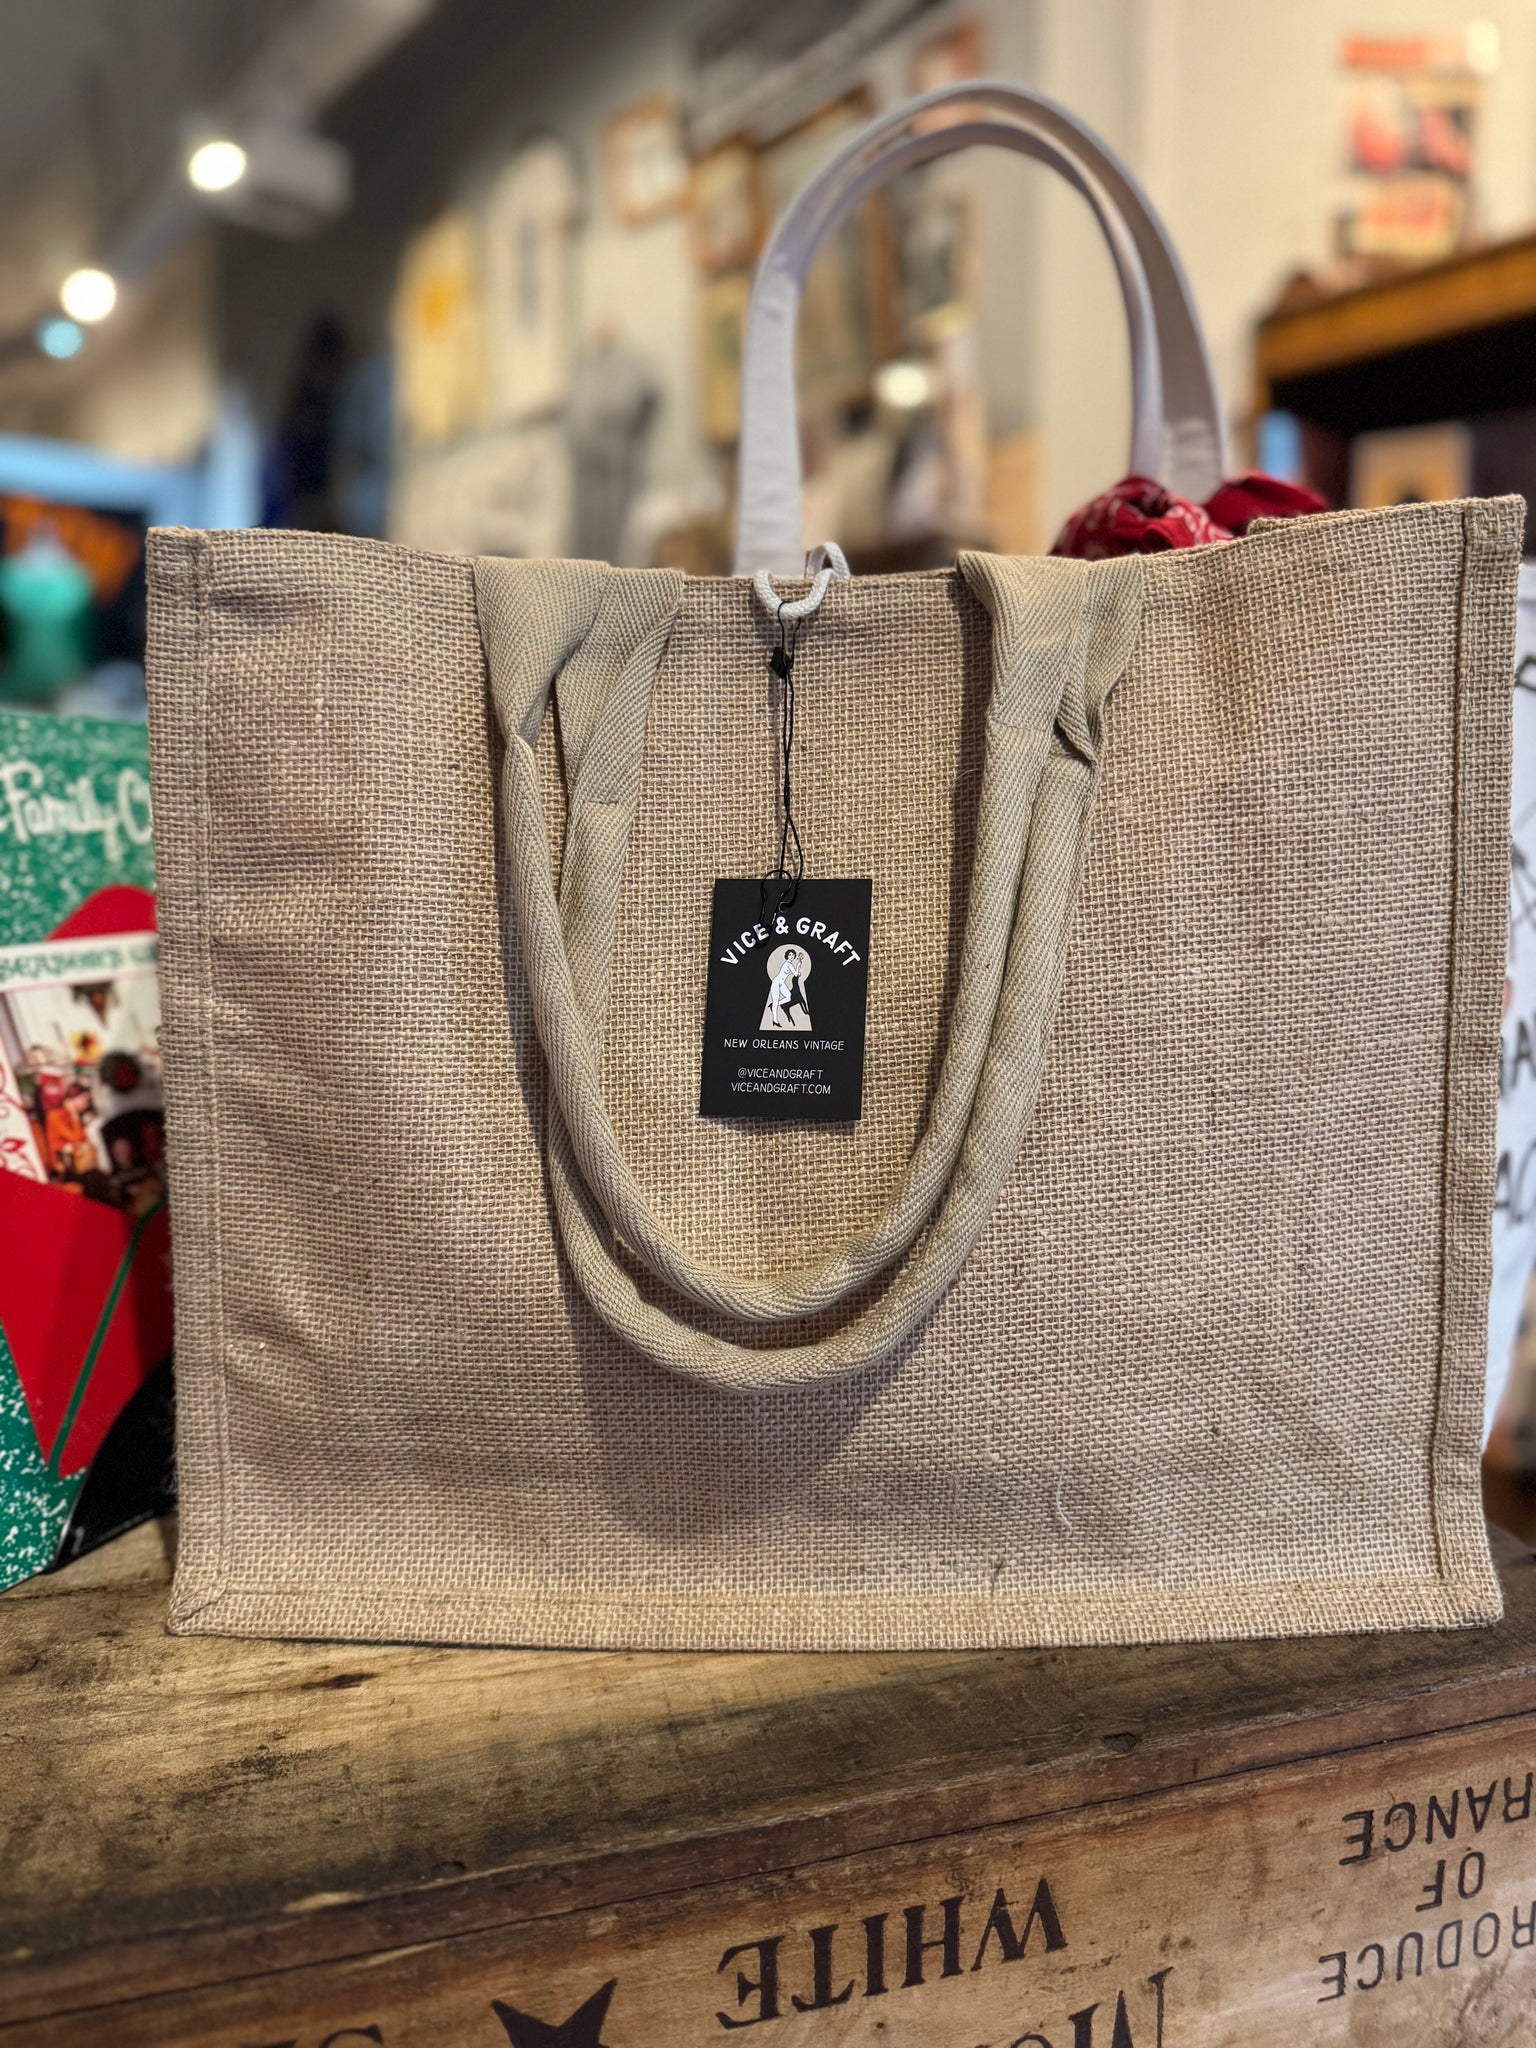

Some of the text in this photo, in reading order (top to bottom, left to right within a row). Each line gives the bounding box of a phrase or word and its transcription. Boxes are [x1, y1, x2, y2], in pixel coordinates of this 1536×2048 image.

[720, 915, 861, 967] VICE & GRAFT
[723, 1038, 845, 1051] NEW ORLEANS VINTAGE
[730, 1081, 831, 1095] VICEANDGRAFT.COM
[737, 1067, 824, 1080] @VICEANDGRAFT
[1415, 1851, 1485, 1913] OF
[716, 1877, 1067, 2030] WHITE
